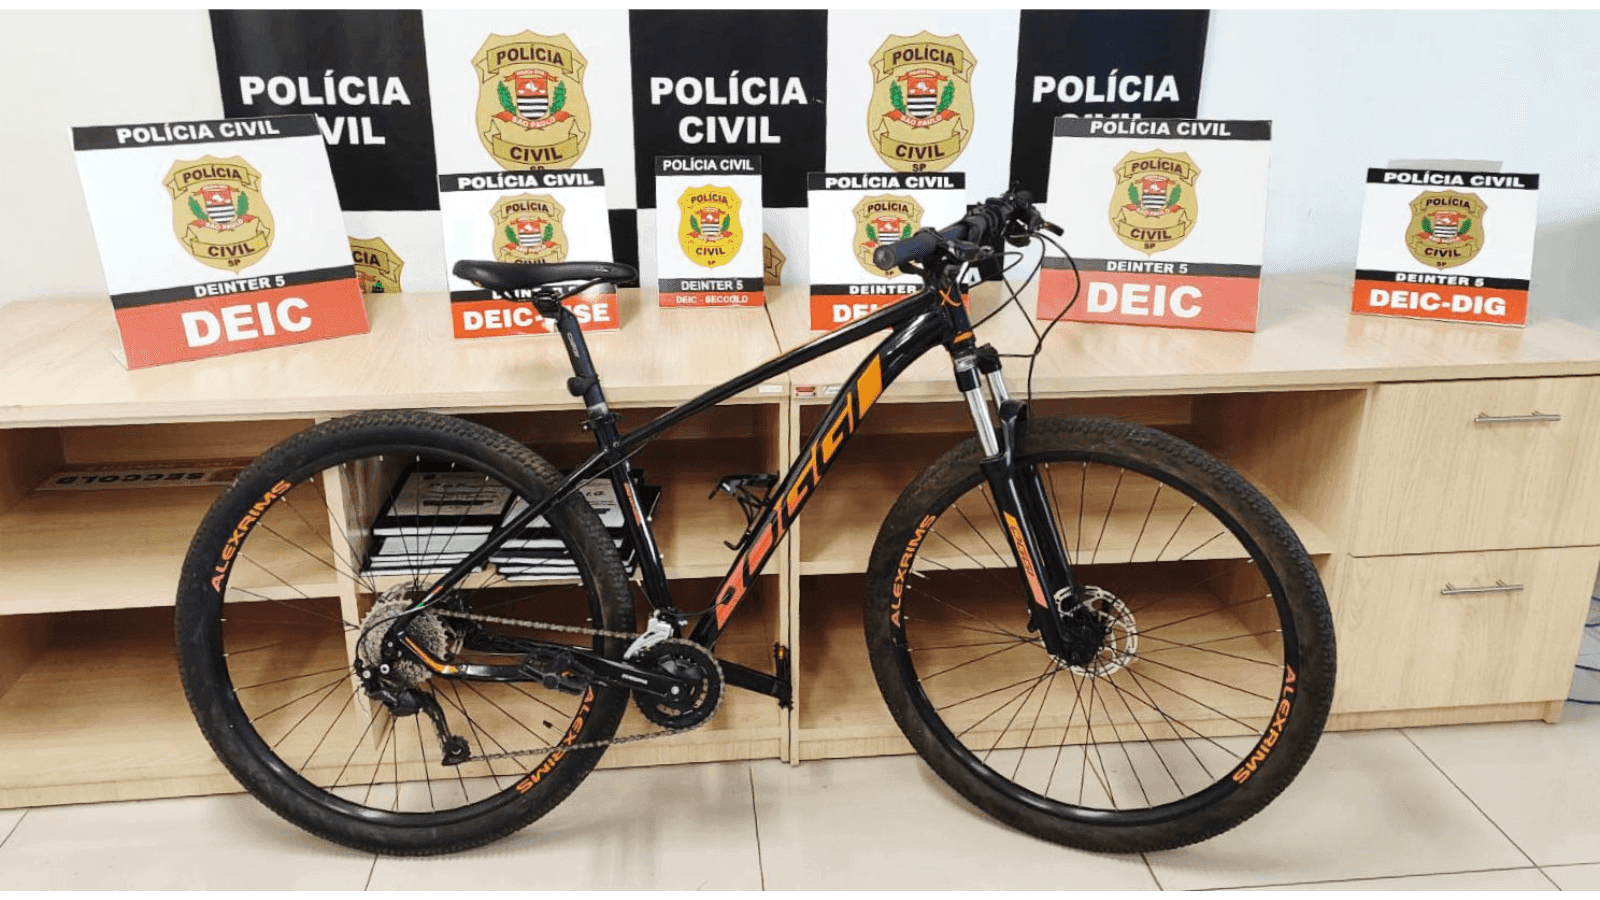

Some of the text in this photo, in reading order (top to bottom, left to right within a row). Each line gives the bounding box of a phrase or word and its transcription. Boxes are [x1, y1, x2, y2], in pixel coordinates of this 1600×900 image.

[496, 43, 564, 66] POLÍCIA
[892, 44, 955, 65] POLÍCIA
[239, 69, 411, 105] POLÍCIA
[650, 70, 808, 105] POLÍCIA
[1032, 69, 1180, 103] POLÍCIA
[116, 120, 280, 144] POLÍCIA CIVIL
[316, 115, 386, 145] VIL
[678, 115, 782, 144] CIVIL
[1090, 119, 1231, 137] POLÍCIA CIVIL
[510, 146, 563, 161] CIVIL
[895, 144, 945, 159] CIVIL
[662, 157, 754, 171] POLÍCIA CIVIL
[912, 163, 927, 172] SP
[1131, 159, 1183, 173] POLÍCIA
[182, 164, 242, 183] POLÍCIA
[457, 172, 594, 190] POLÍCIA CIVIL
[825, 174, 954, 189] POLÍCIA CIVIL
[1383, 171, 1525, 188] POLÍCIA CIVIL
[690, 193, 728, 204] POLÍCIA
[1426, 198, 1470, 209] POLÍCIA
[505, 200, 550, 214] POLÍCIA
[867, 202, 908, 213] POLÍCIA
[1130, 228, 1172, 240] CIVIL
[207, 243, 255, 257] CIVIL
[695, 247, 726, 255] CIVIL
[1424, 247, 1461, 257] CIVIL
[227, 259, 240, 267] SP
[1107, 260, 1188, 274] DEINTER 5
[195, 275, 285, 297] DEINTER 5
[681, 280, 743, 290] DEINTER 5
[1395, 273, 1484, 287] DEINTER 5
[849, 285, 917, 295] DEINTER
[675, 296, 697, 304] DEIC
[1087, 282, 1203, 317] DEIC
[1369, 289, 1507, 316] DEIC-DIG
[181, 297, 313, 348] DEIC
[211, 480, 292, 593] ALEXRIMS
[890, 514, 937, 628] ALEXRIMS
[1233, 664, 1296, 784] ALEXRIMS
[516, 685, 595, 794] ALEXRIMS
